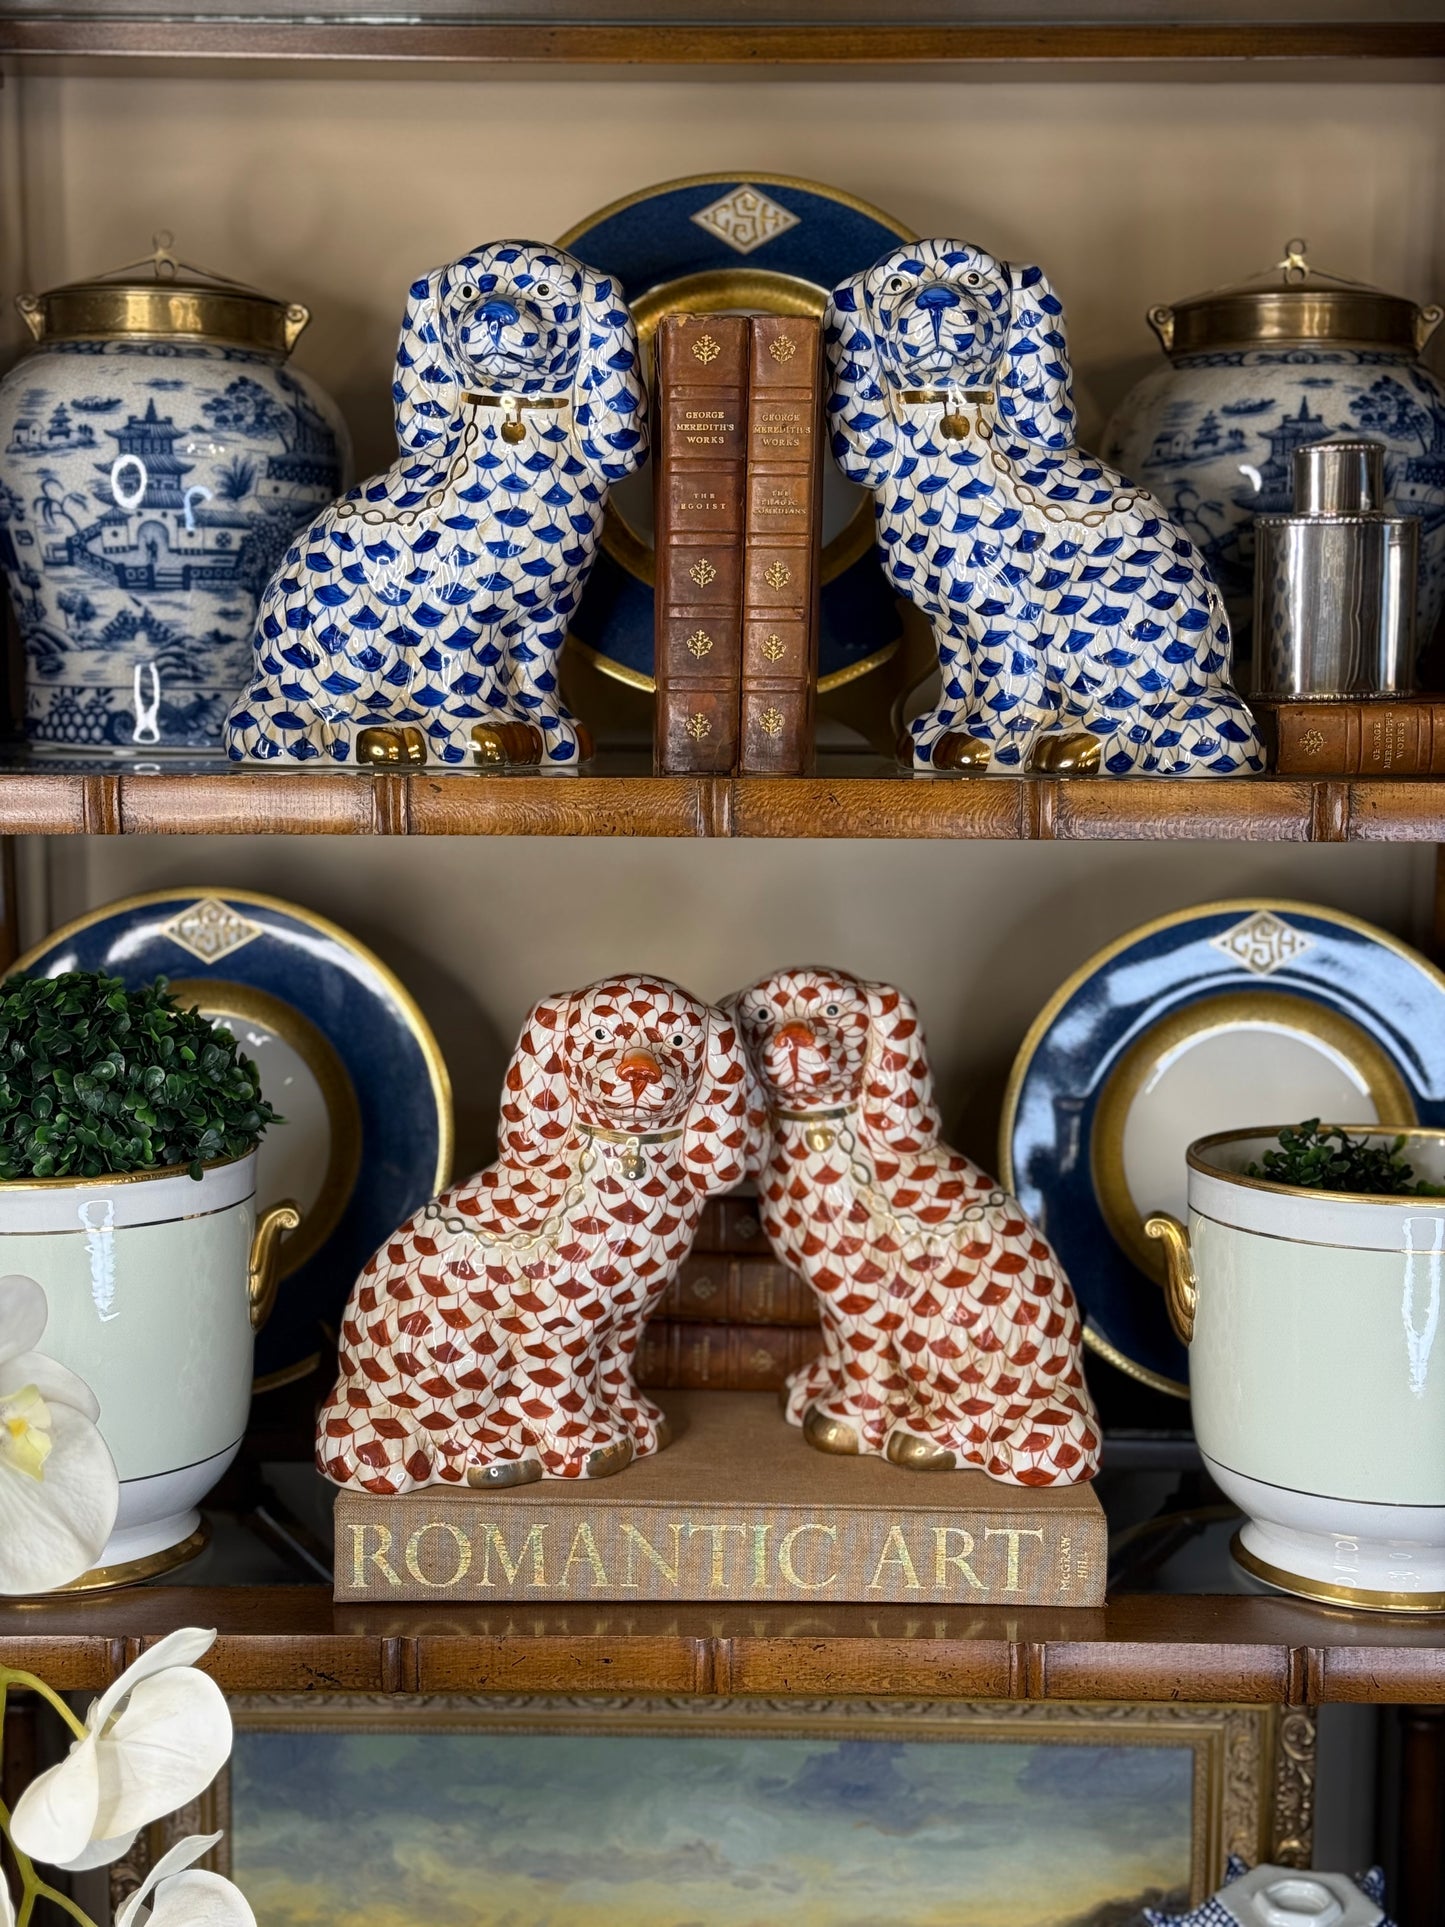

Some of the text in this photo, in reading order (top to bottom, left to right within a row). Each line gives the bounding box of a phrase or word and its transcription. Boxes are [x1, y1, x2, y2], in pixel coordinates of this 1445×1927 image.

[685, 411, 725, 419] GEORGE
[762, 413, 800, 422] GEORGE
[676, 423, 735, 431] MEREDITH'S
[686, 436, 725, 444] WORKS
[762, 438, 800, 447] WORKS
[1396, 722, 1405, 759] WORKS
[347, 1522, 1044, 1594] ROMANTIC ART
[1077, 1552, 1089, 1579] HILL
